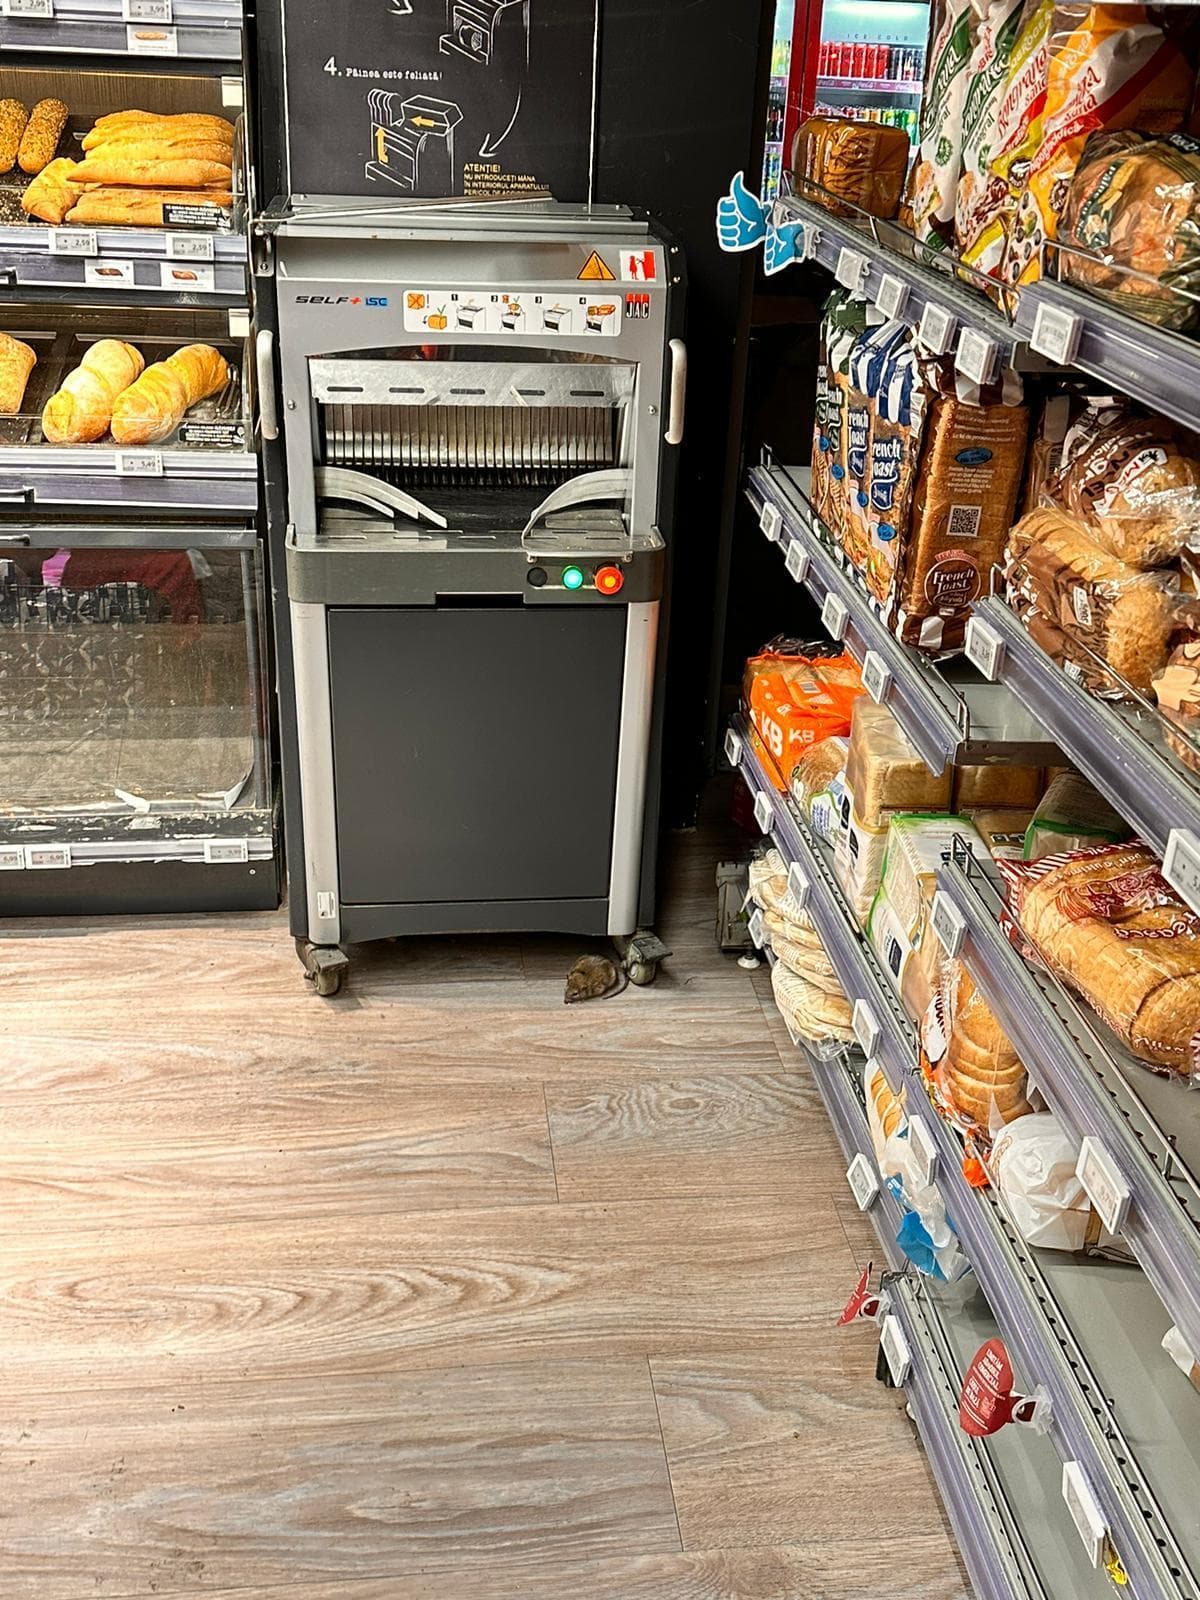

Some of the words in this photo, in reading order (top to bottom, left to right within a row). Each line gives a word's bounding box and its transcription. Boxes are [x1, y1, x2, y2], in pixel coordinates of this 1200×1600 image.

[323, 56, 342, 77] 4.
[382, 70, 403, 80] este
[626, 301, 649, 318] JAC
[933, 569, 975, 585] French
[937, 579, 967, 594] Toast
[760, 710, 784, 758] KB
[789, 727, 816, 744] KB
